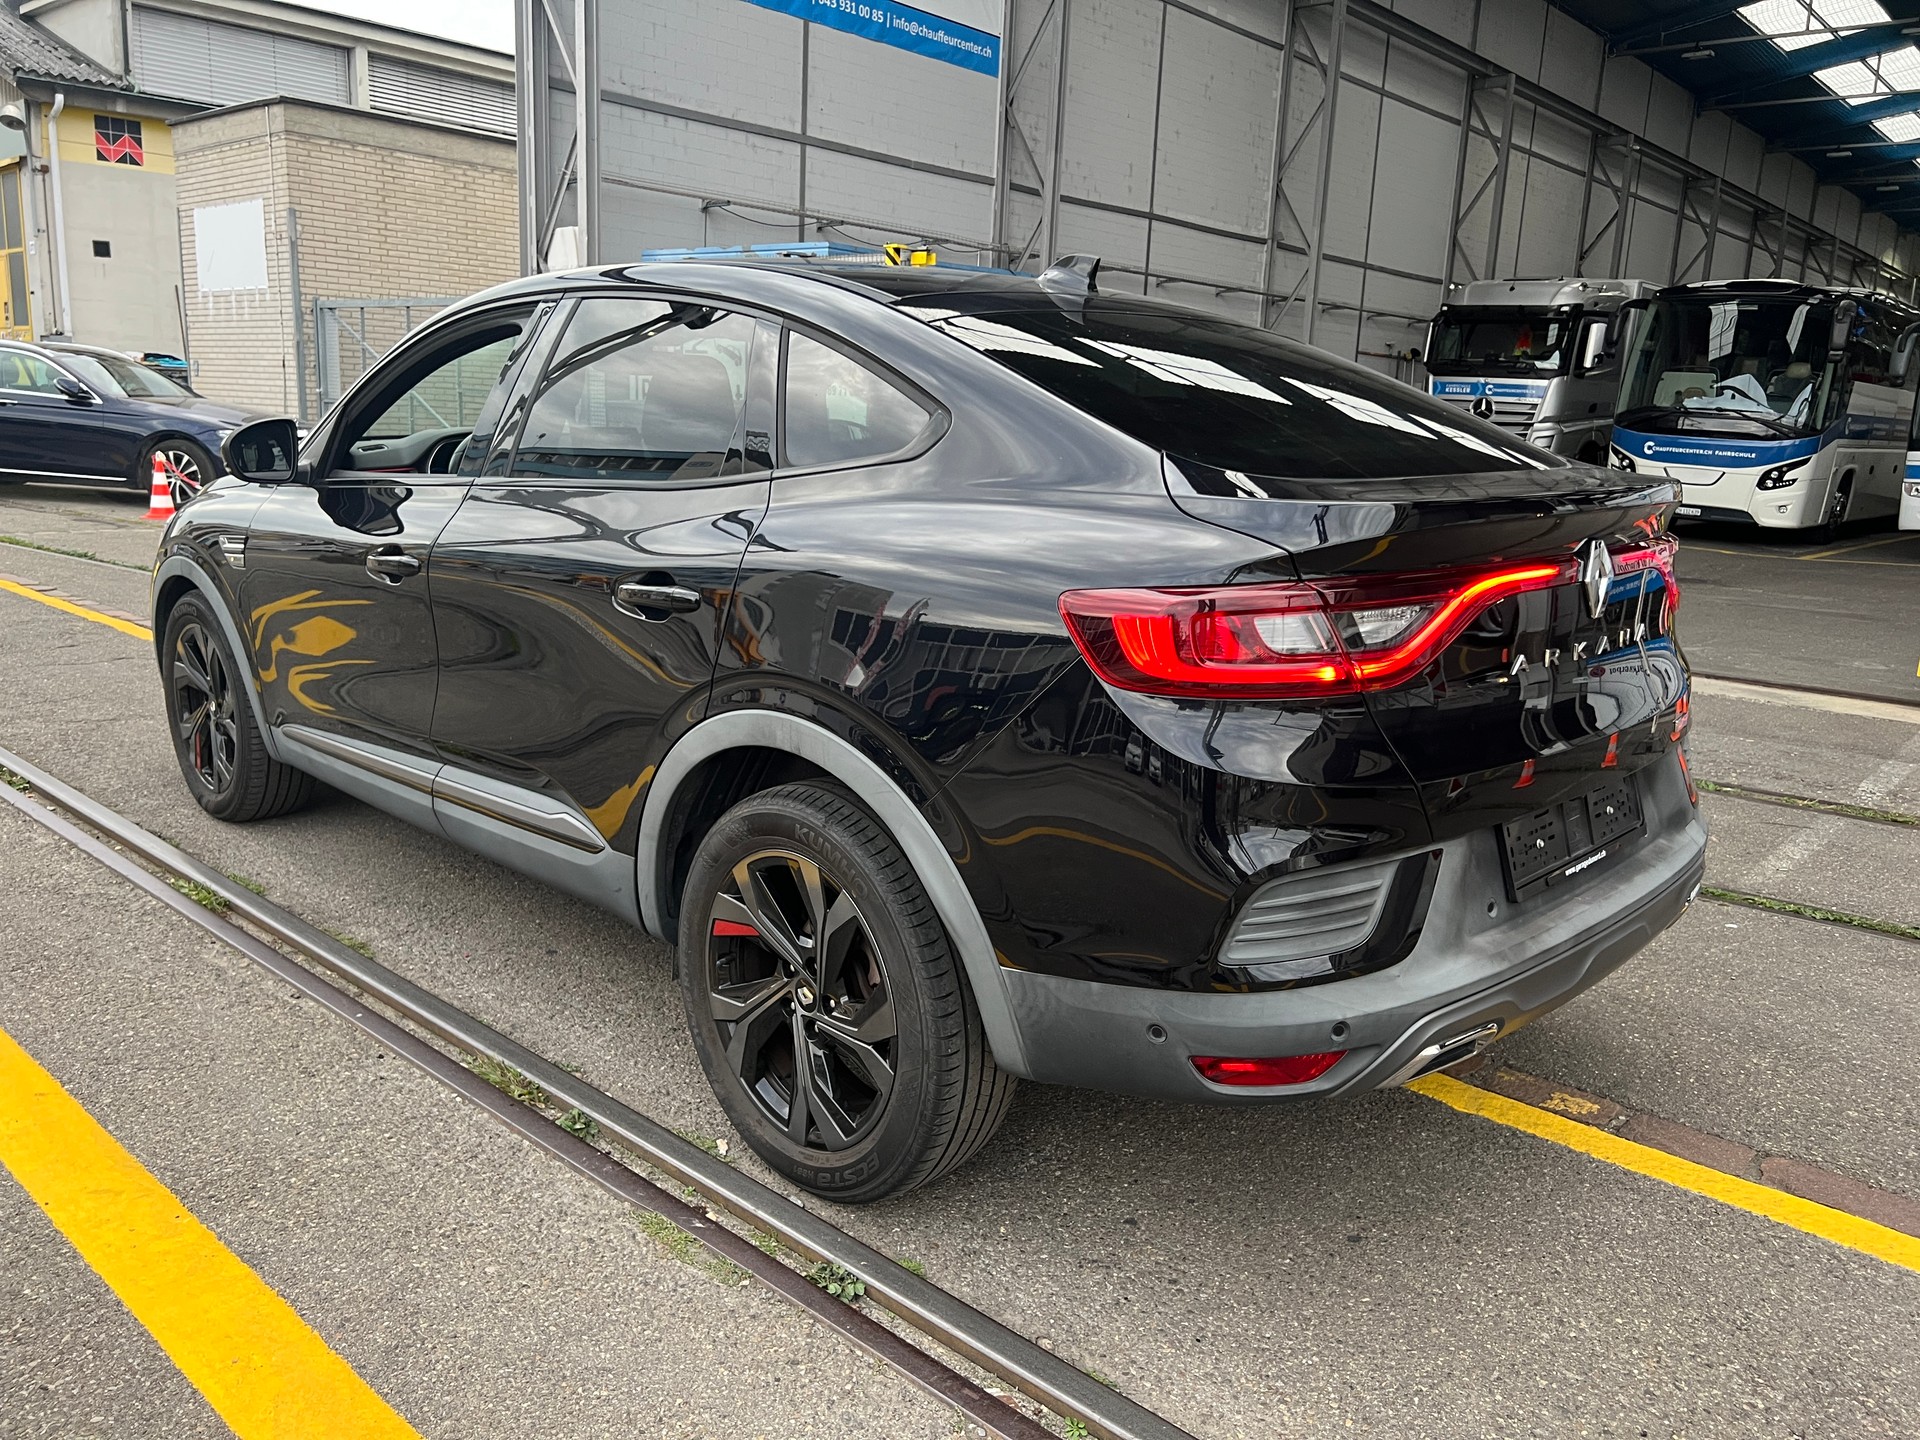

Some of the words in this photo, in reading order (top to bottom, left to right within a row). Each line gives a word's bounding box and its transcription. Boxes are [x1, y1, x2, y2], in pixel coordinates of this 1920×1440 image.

[839, 0, 857, 15] 931
[858, 4, 870, 19] 00
[871, 9, 884, 23] 85
[892, 15, 992, 58] info@chauffeurcenter.ch
[1715, 450, 1756, 459] FAHRSCHULE
[1509, 623, 1645, 676] ARKANA
[794, 823, 868, 899] KUMHO
